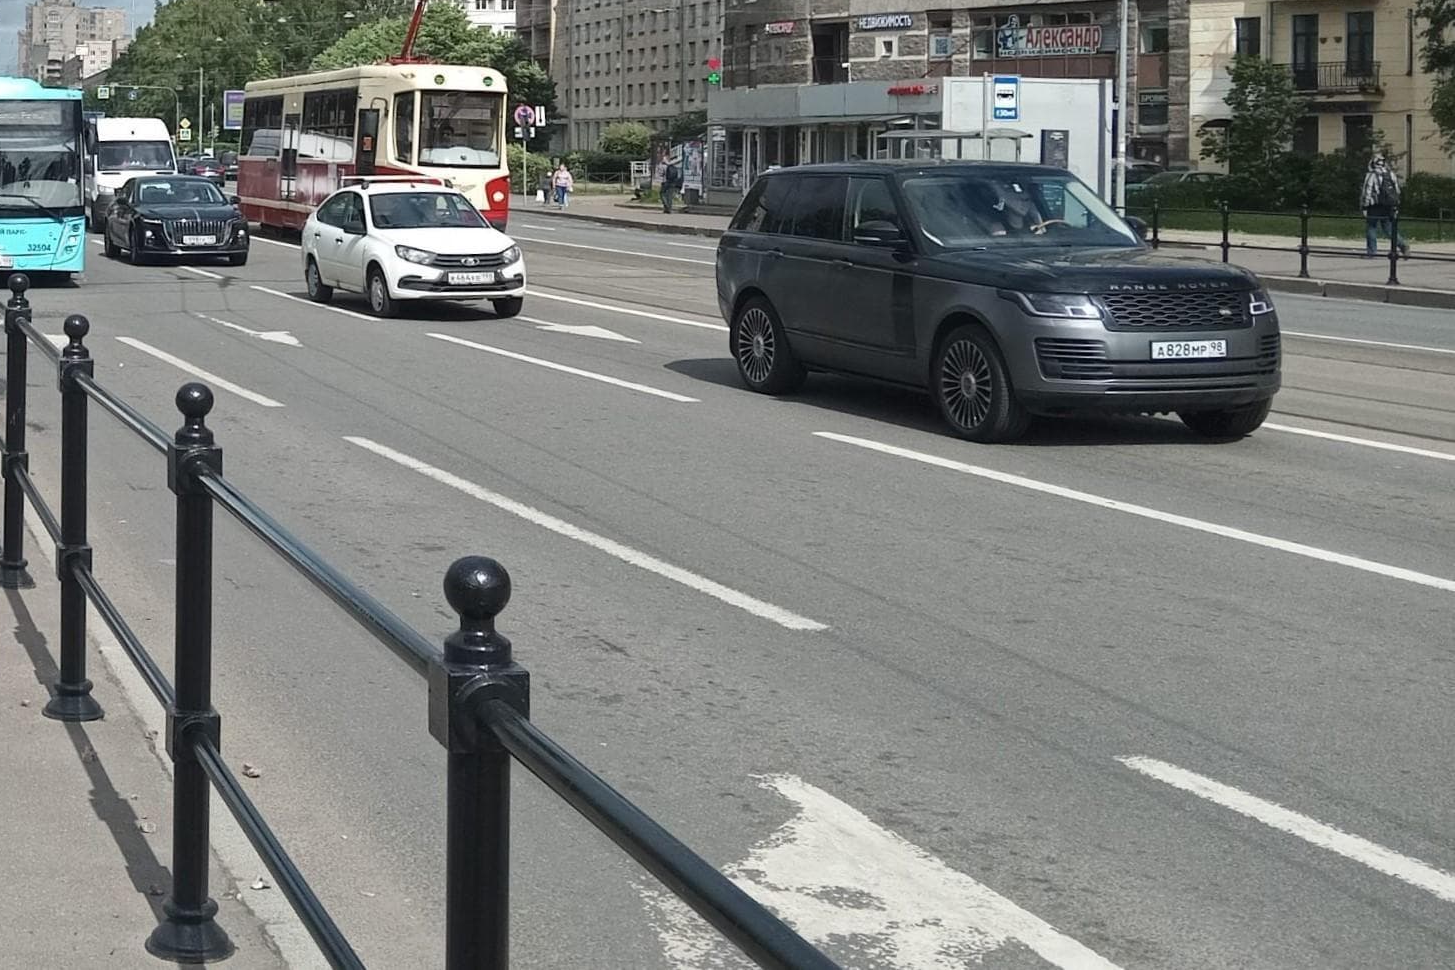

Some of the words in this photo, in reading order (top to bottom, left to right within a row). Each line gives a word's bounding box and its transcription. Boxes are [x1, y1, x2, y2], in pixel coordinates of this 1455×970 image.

[1026, 25, 1100, 49] Александр
[27, 244, 52, 252] 32504
[1157, 343, 1207, 357] А828МР
[1210, 342, 1223, 352] 98
